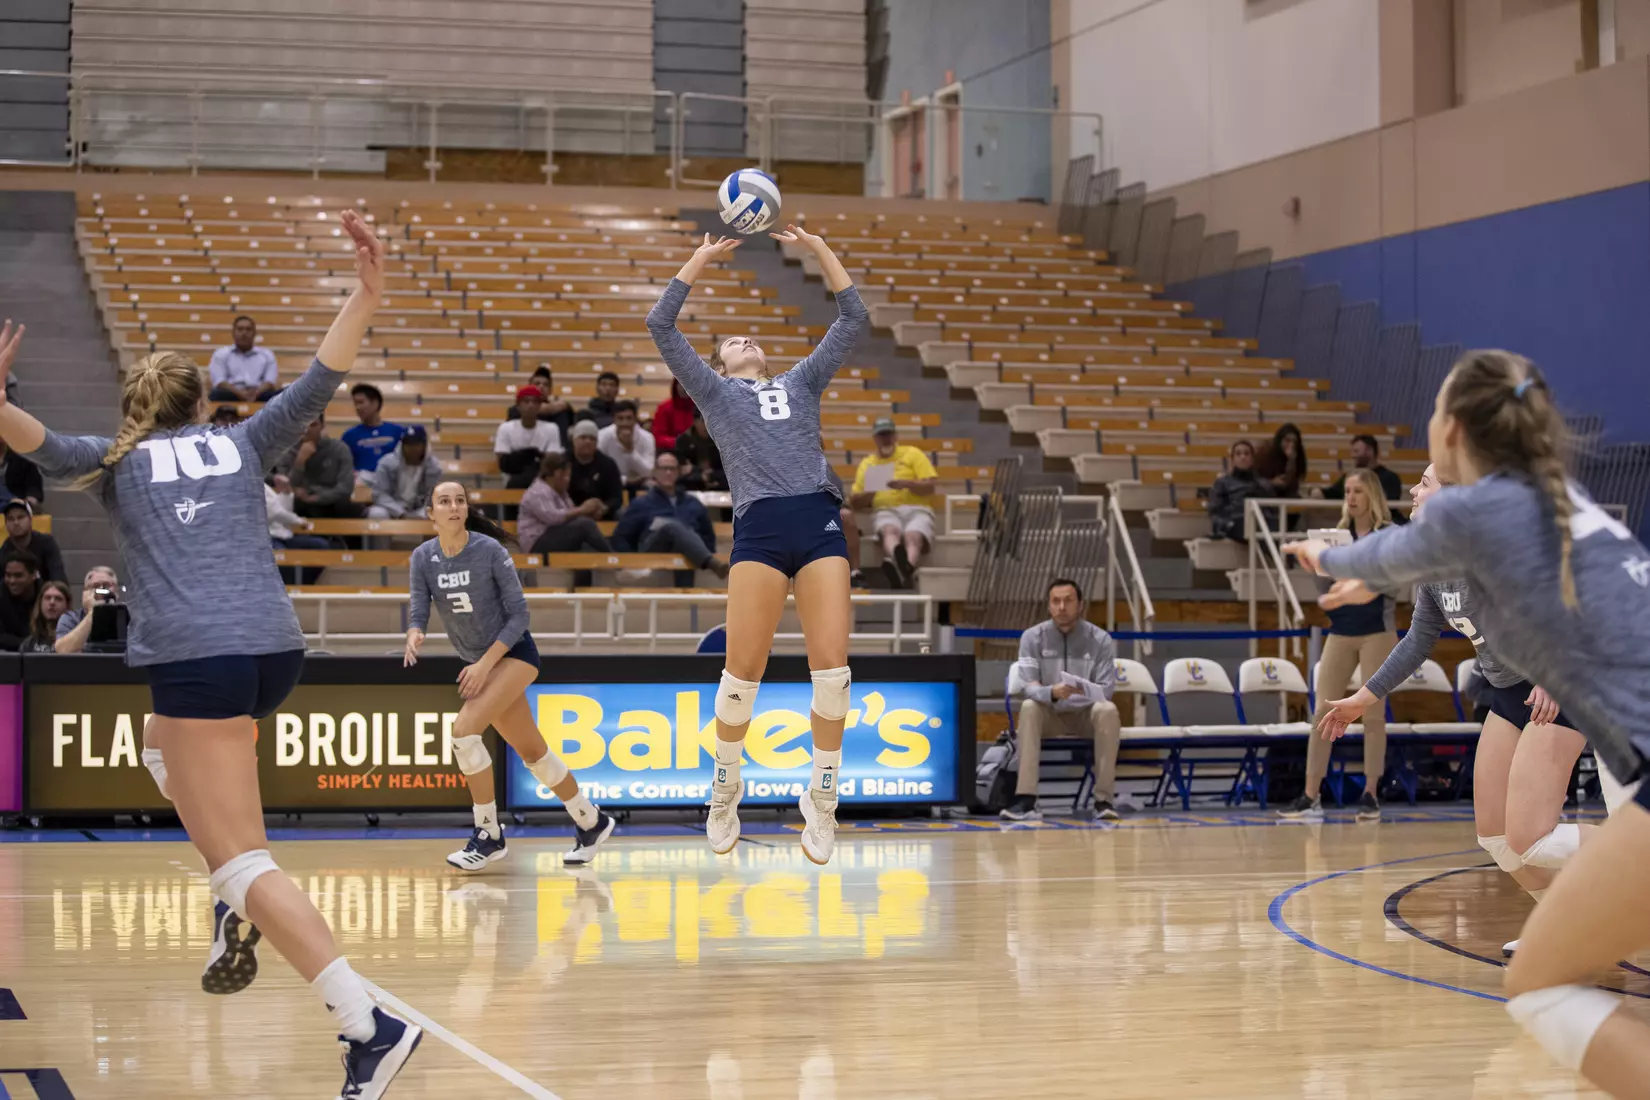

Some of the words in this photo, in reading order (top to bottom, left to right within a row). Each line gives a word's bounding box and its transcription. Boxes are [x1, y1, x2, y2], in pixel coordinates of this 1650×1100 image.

[758, 389, 791, 420] 8
[137, 431, 242, 483] 10
[437, 570, 470, 588] CBU
[446, 592, 474, 614] 3
[53, 713, 152, 767] FLA
[317, 774, 383, 789] SIMPLY
[578, 781, 622, 799] The
[628, 781, 710, 799] Corner
[747, 780, 804, 797] Iowa
[862, 778, 934, 796] Blaine
